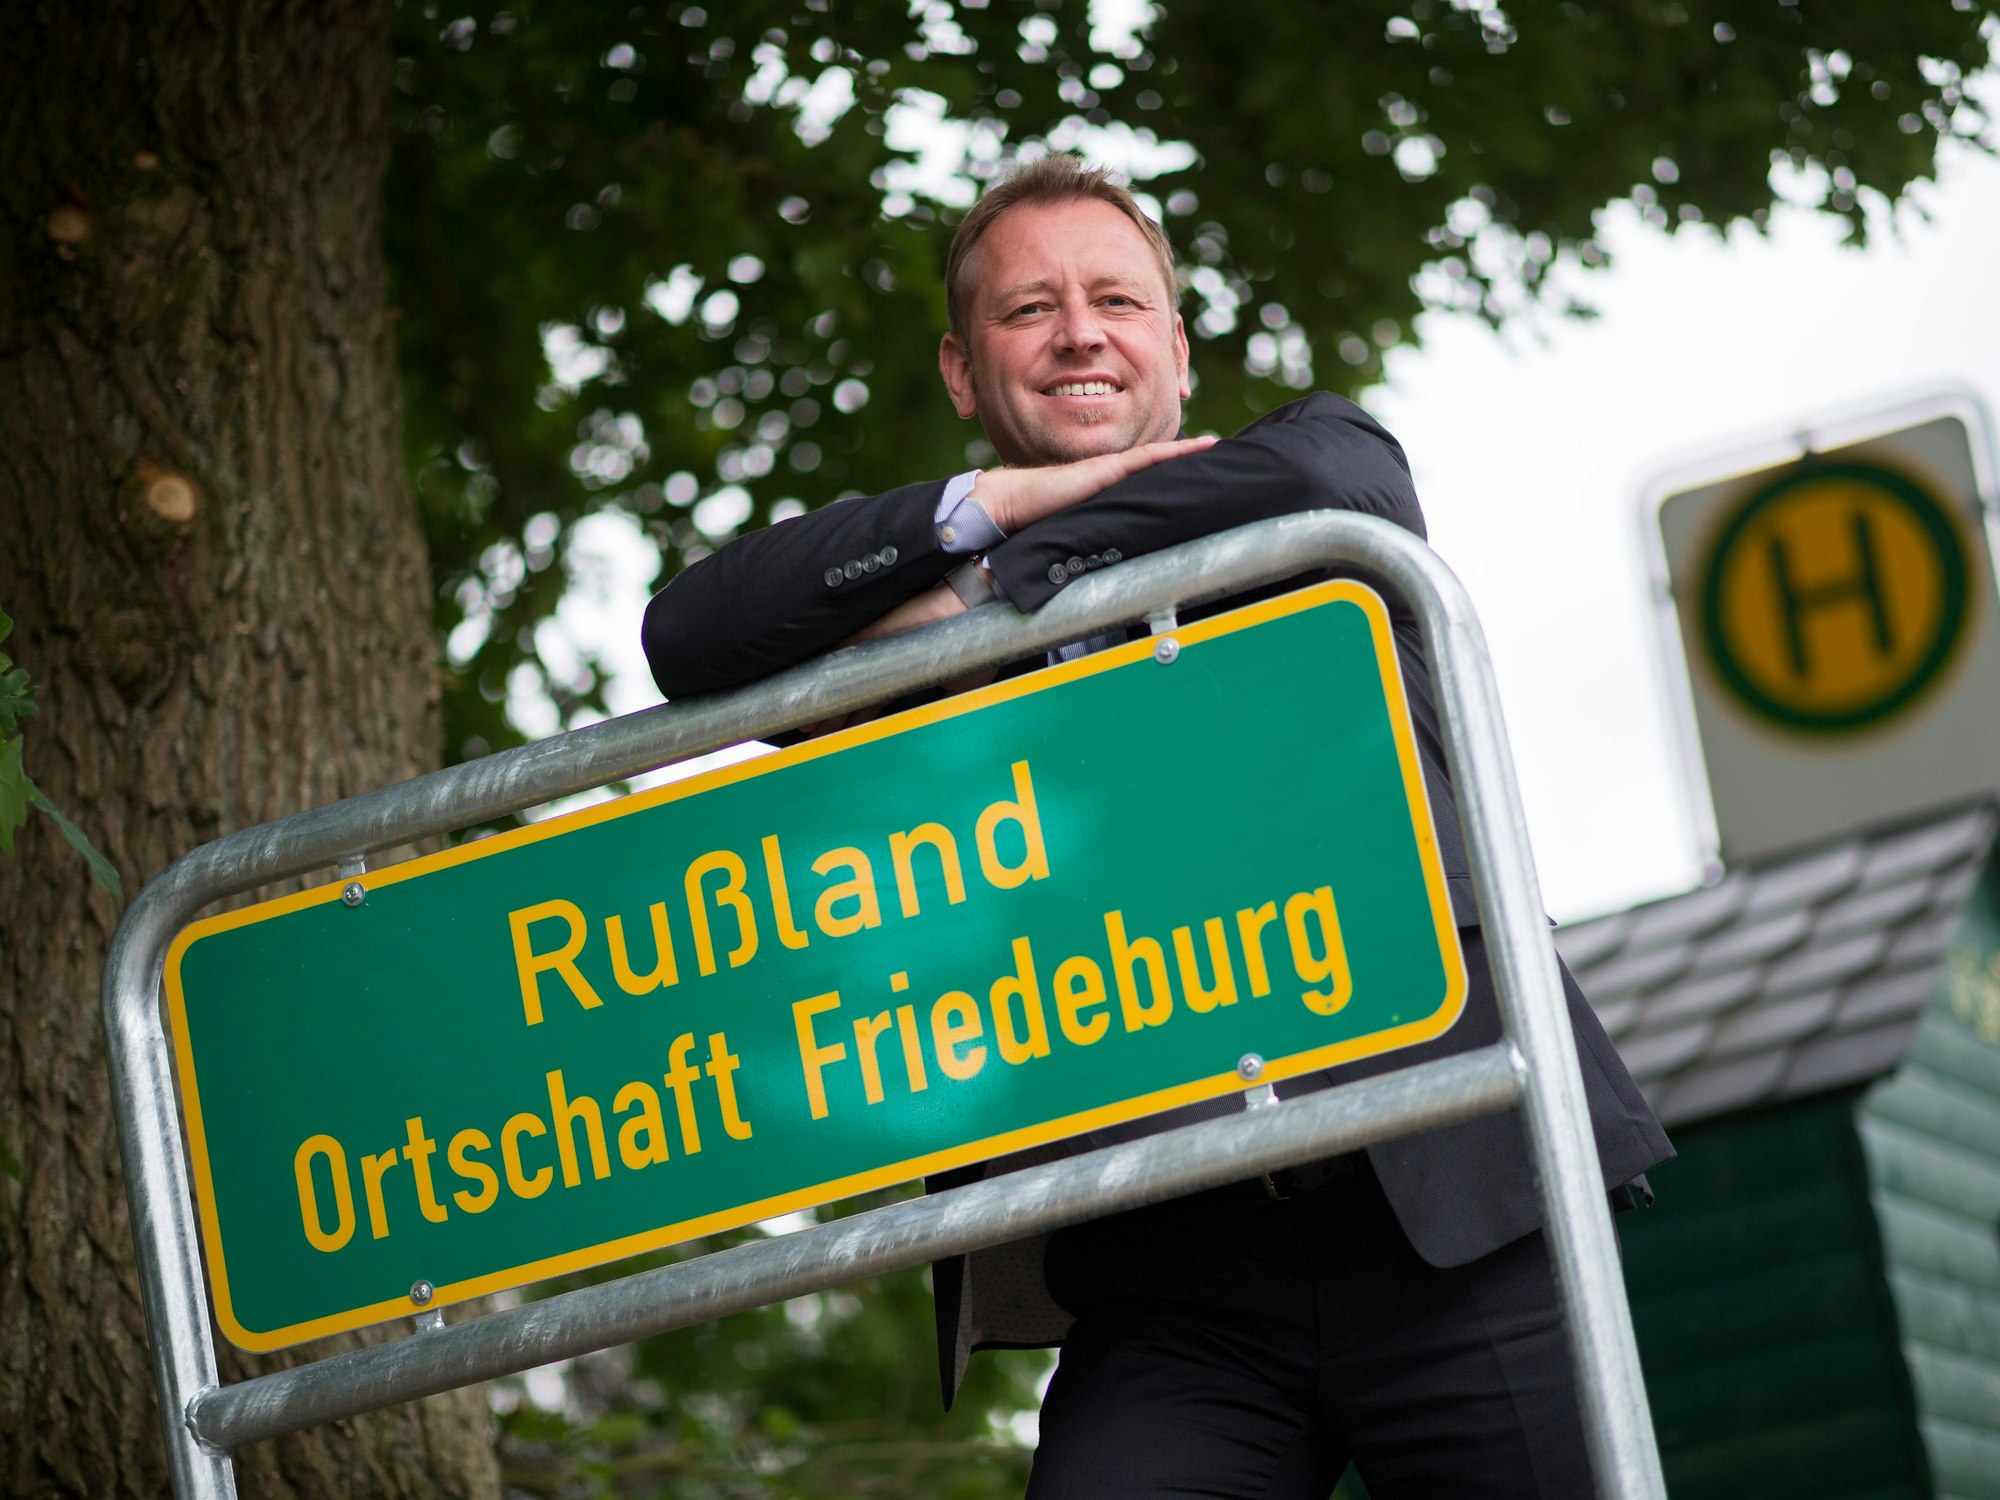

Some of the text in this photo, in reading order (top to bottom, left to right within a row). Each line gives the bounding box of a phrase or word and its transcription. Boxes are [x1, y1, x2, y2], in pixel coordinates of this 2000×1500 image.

[1764, 509, 1892, 678] H
[508, 761, 1050, 1026] Rußland
[294, 886, 1352, 1253] Ortschaft Friedeburg
